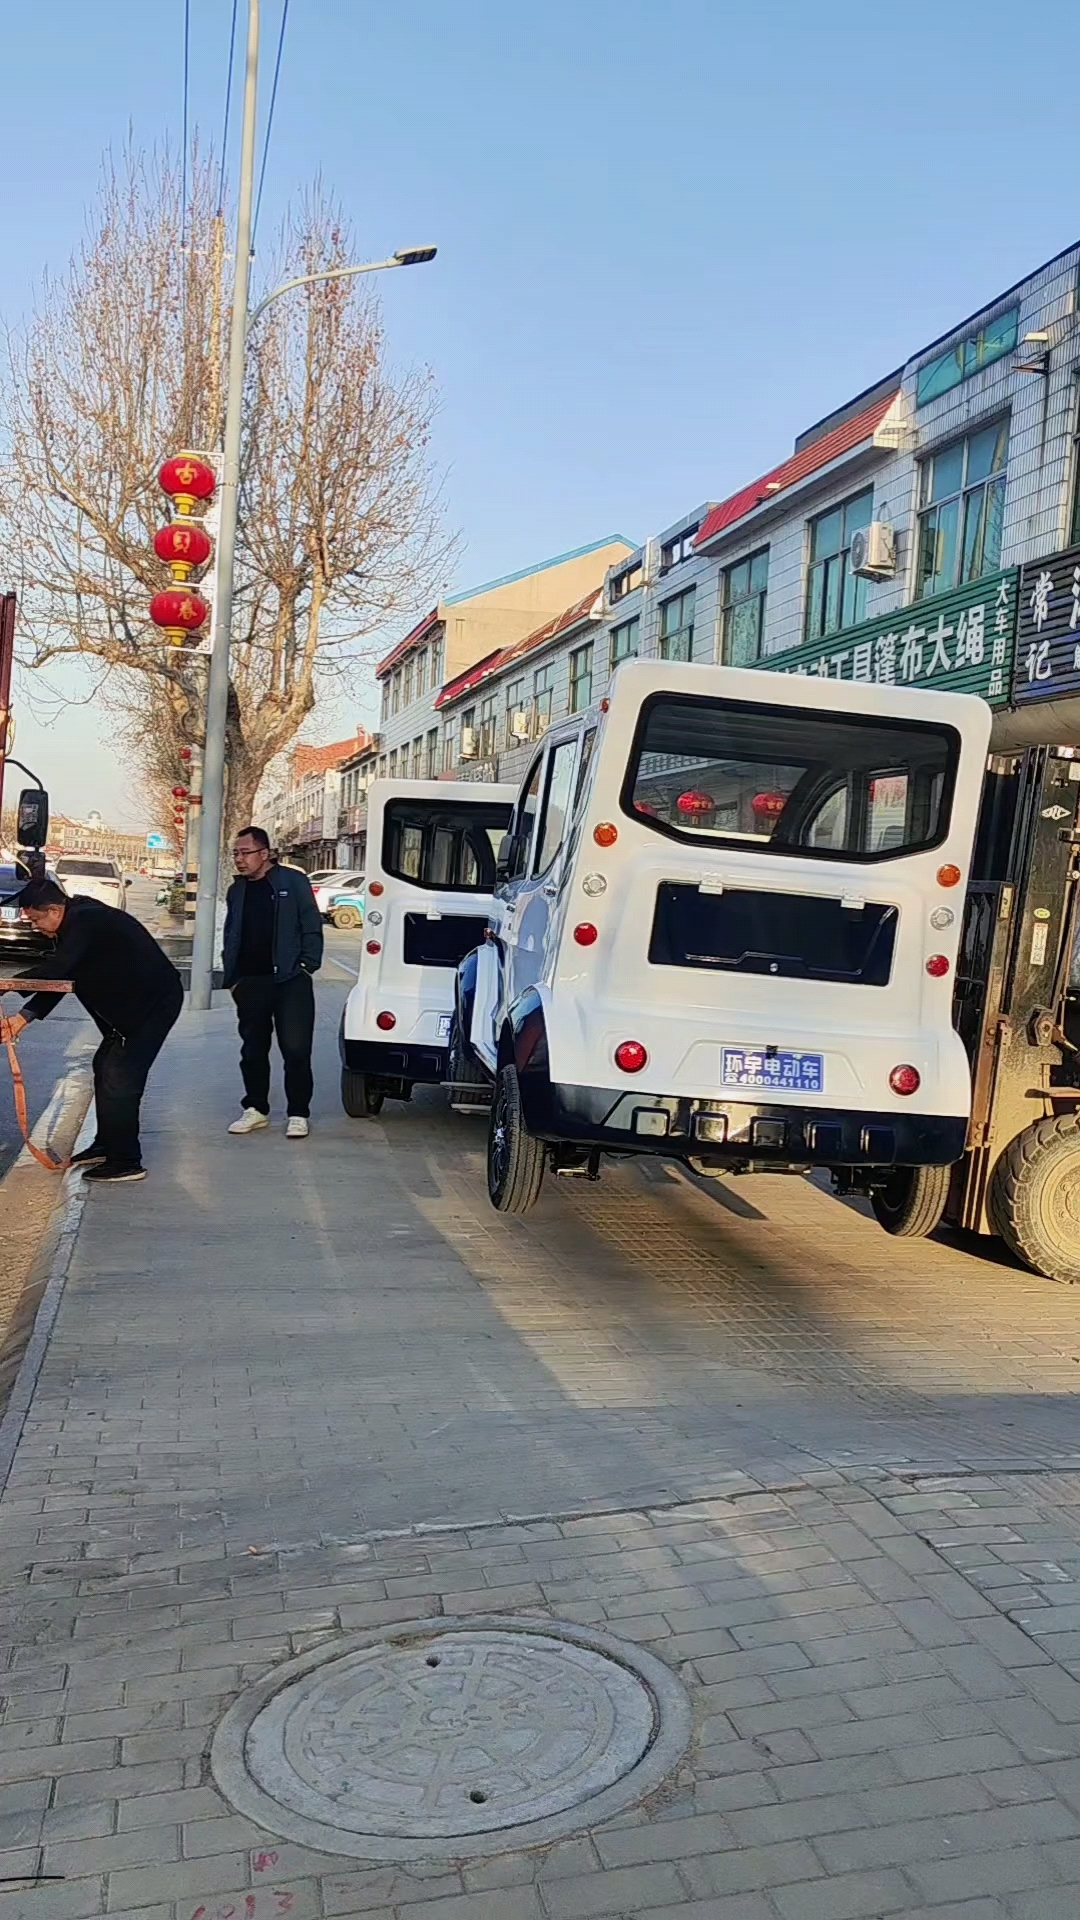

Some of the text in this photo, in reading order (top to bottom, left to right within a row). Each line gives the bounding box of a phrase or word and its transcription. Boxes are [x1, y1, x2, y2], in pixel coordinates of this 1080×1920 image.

[988, 578, 1010, 697] 大车用品
[725, 1053, 819, 1079] 环宇电动车
[739, 1073, 819, 1089] 4000441110
